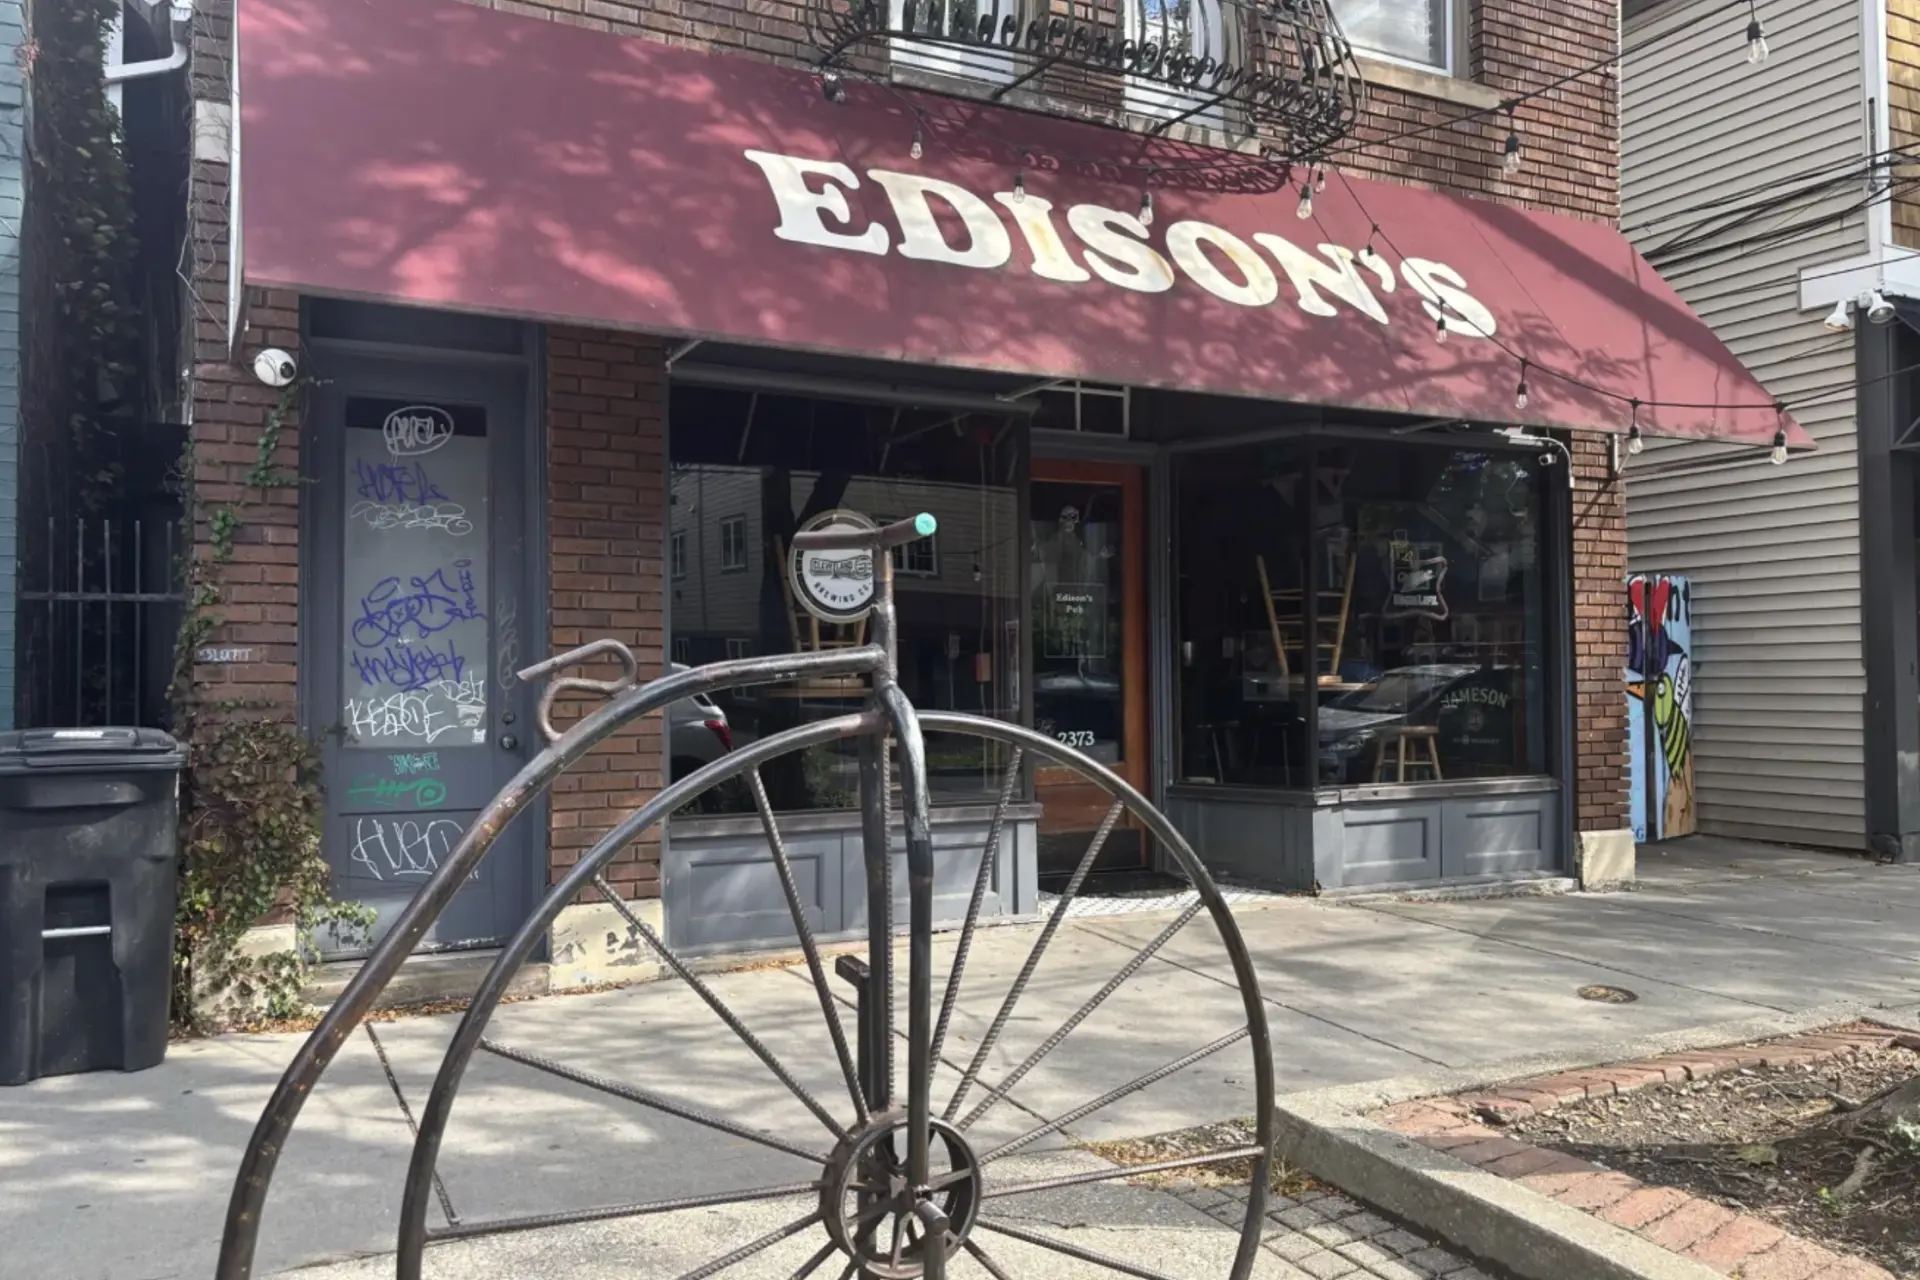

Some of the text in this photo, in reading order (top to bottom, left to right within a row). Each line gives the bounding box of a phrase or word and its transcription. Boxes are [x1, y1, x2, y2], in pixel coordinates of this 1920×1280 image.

[744, 149, 1497, 337] EDISON'S
[814, 582, 856, 603] BREWING
[1056, 593, 1093, 603] Edison's
[1066, 605, 1084, 615] Pub
[1441, 687, 1509, 709] JAMESON
[1057, 731, 1095, 748] 2373
